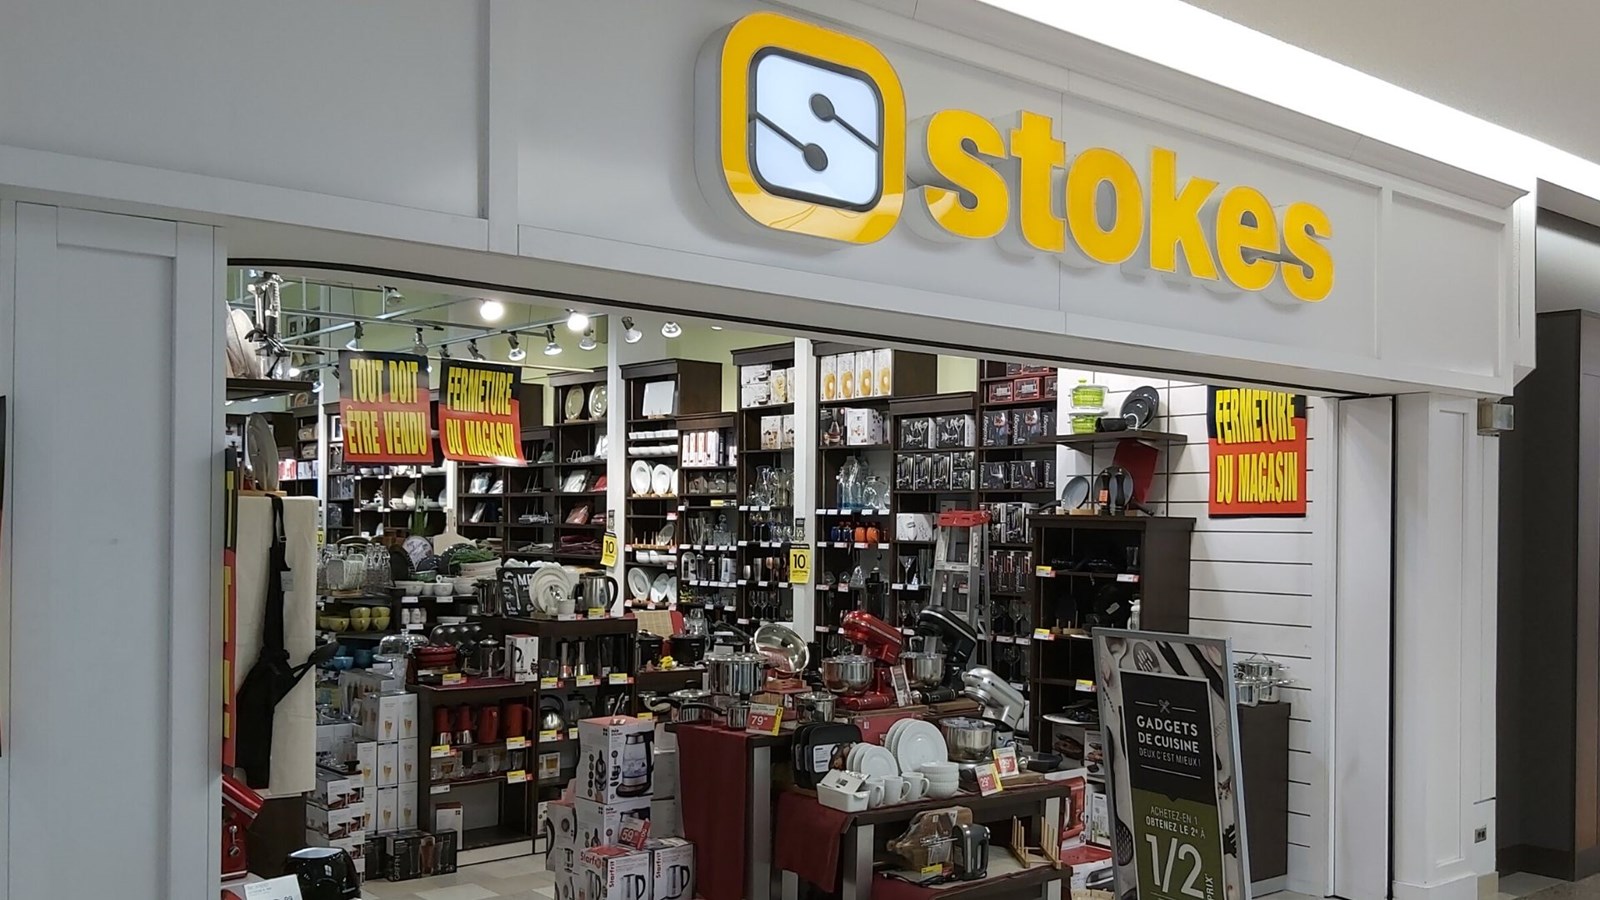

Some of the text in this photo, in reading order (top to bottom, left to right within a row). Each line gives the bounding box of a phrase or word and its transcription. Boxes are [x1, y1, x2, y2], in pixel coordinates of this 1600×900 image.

[925, 109, 1335, 302] stokes
[350, 358, 419, 404] TOUT DOIT
[447, 366, 514, 416] FERMETURE
[346, 405, 427, 456] ÊTRE VENDU
[1215, 388, 1296, 444] FERMETURE
[446, 418, 517, 458] DU MAGASIN
[1216, 450, 1298, 505] DU MAGASIN
[605, 540, 615, 554] 10
[793, 554, 806, 569] 10
[1136, 715, 1198, 737] GADGETS
[1138, 732, 1199, 753] DE CUISINE
[1139, 747, 1156, 758] DEUX
[1156, 751, 1175, 763] C'EST
[1145, 815, 1177, 832] OBTENEZ
[1180, 824, 1189, 835] LE
[1200, 827, 1206, 839] À
[1150, 806, 1198, 825] ACHETEZ-EN 1
[1145, 833, 1205, 899] 1/2
